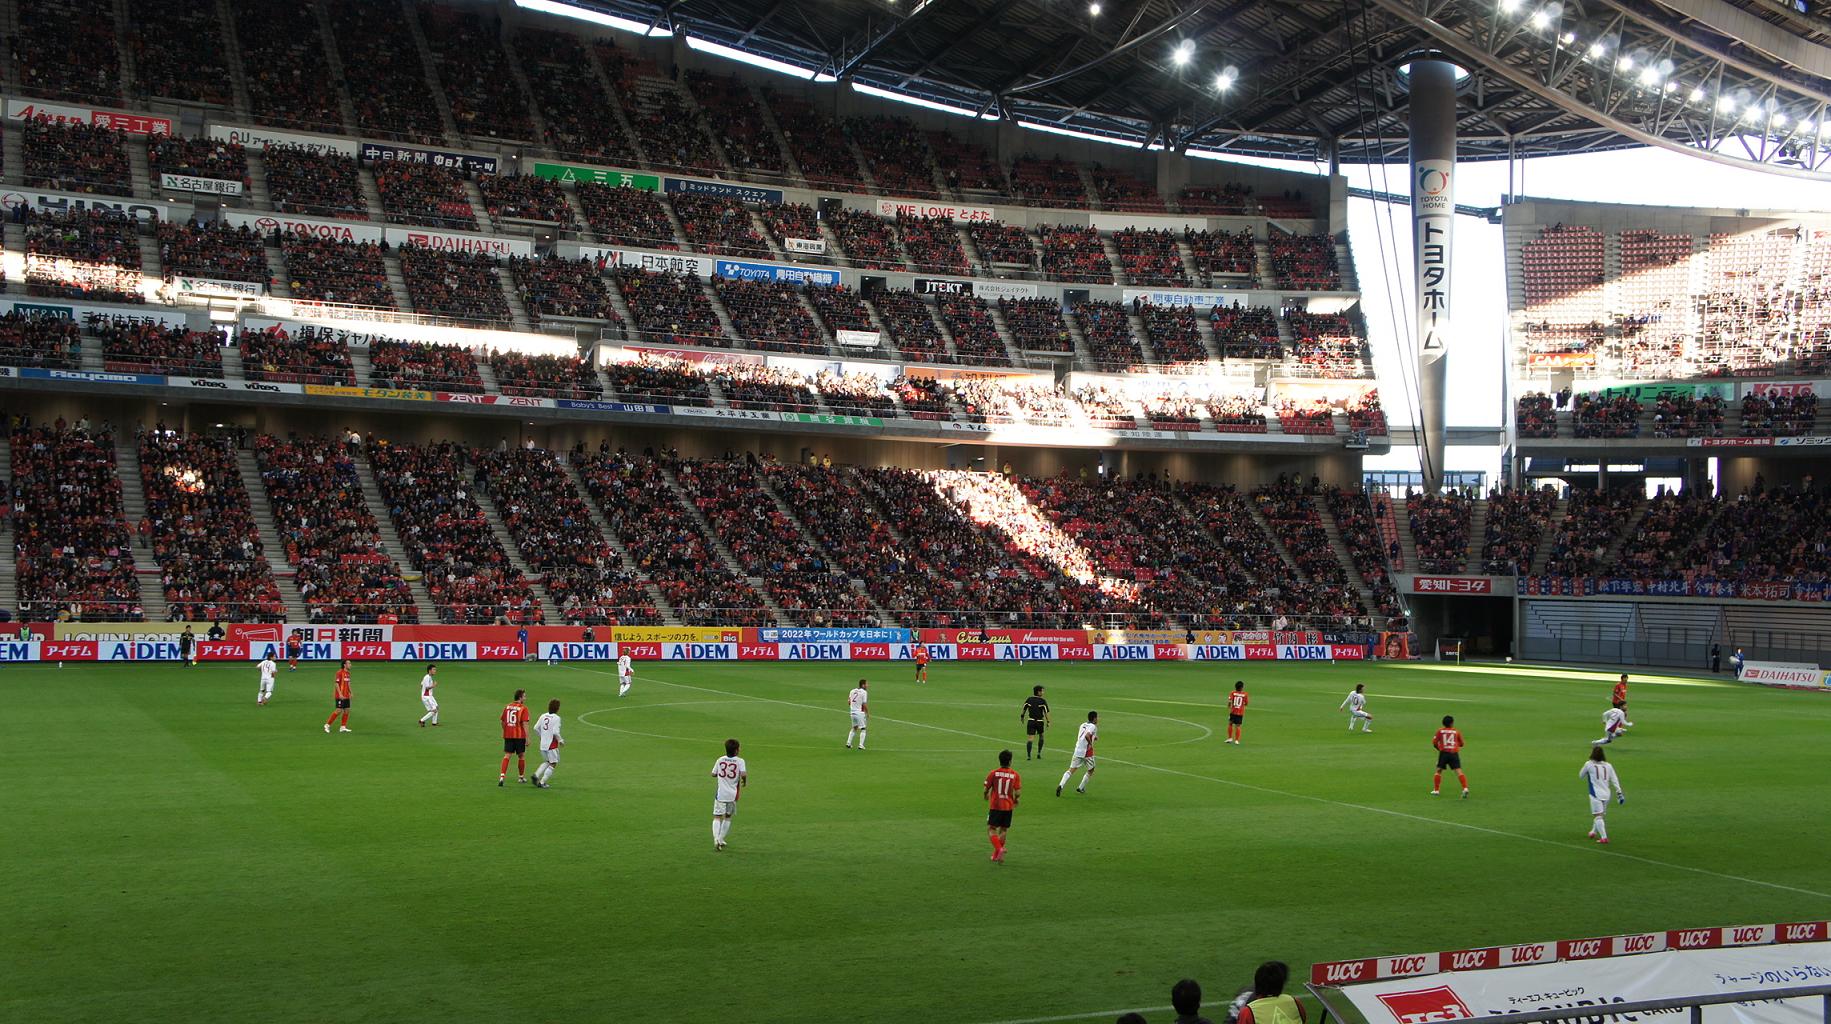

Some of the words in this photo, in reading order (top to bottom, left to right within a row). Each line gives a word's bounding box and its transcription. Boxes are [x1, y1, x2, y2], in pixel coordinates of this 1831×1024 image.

[95, 114, 168, 135] 愛三工業
[366, 147, 427, 165] 中日新聞
[180, 177, 236, 194] 名古屋銀行
[896, 204, 916, 216] WE
[921, 207, 955, 218] LOVE
[959, 209, 991, 221] とよた
[284, 222, 353, 240] TOYOTA
[432, 235, 510, 254] DAIHATSU
[641, 254, 699, 273] 日本航空
[196, 280, 256, 295] 名古屋銀行
[925, 281, 963, 294] JTEKT
[1424, 222, 1445, 350] トヨタホーム
[448, 393, 484, 404] ZENT
[509, 397, 543, 407] ZENT
[1419, 578, 1486, 592] 愛知トヨタ
[956, 631, 1012, 644] Grapus
[47, 645, 92, 657] アイテム
[202, 645, 244, 657] アイテム
[263, 643, 331, 660] AiEM
[346, 645, 386, 657] アイテム
[481, 645, 519, 657] アイテム
[741, 646, 775, 657] アイテム
[854, 647, 886, 657] アイテム
[900, 644, 950, 660] AiEM
[960, 647, 991, 657] アイテム
[1062, 647, 1091, 657] アイテム
[1157, 647, 1185, 657] アイテム
[1248, 647, 1274, 657] アイテム
[1334, 647, 1359, 657] アイテム
[1760, 670, 1817, 683] DAIHATSU
[1233, 695, 1243, 707] 10
[506, 709, 517, 725] 16
[543, 717, 550, 731] 3
[1442, 733, 1456, 746] 14
[718, 761, 738, 779] 33
